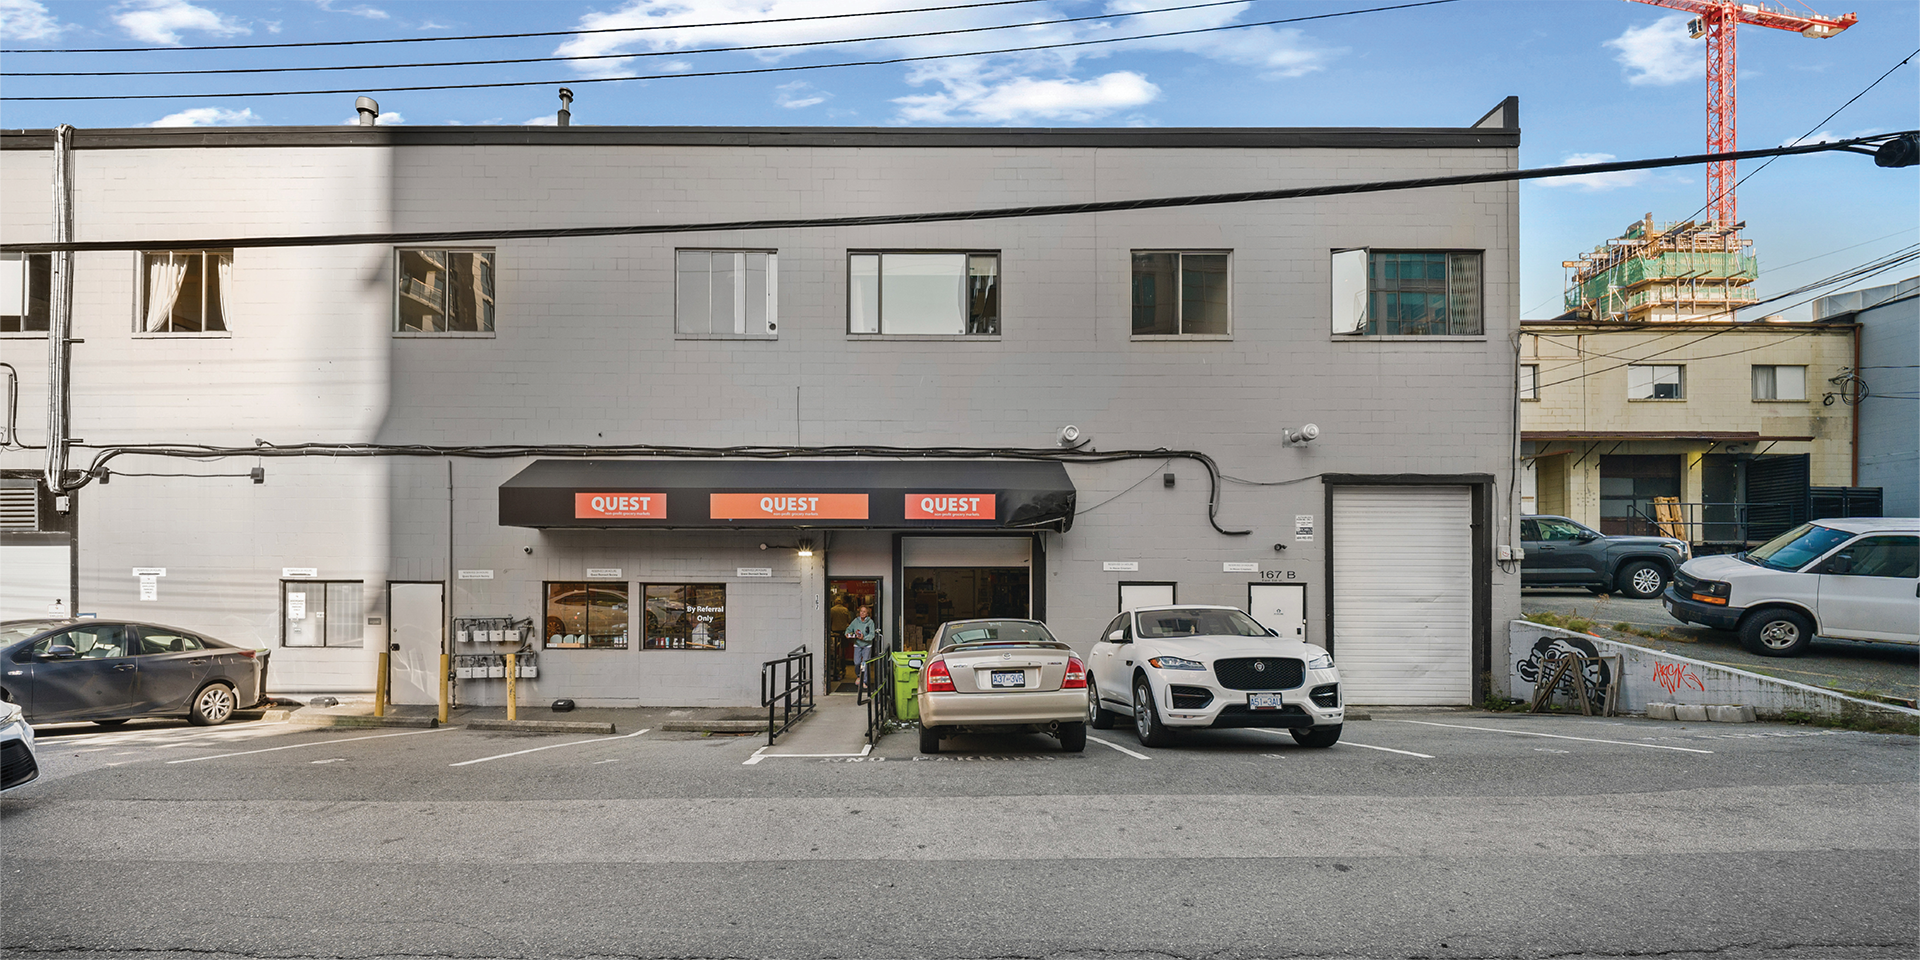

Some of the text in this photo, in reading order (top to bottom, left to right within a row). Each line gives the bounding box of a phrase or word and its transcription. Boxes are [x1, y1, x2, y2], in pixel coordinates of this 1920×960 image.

[591, 496, 651, 512] QUEST
[760, 497, 818, 513] QUEST
[921, 497, 980, 513] QUEST
[1259, 570, 1296, 579] 167 B
[697, 615, 714, 623] Only
